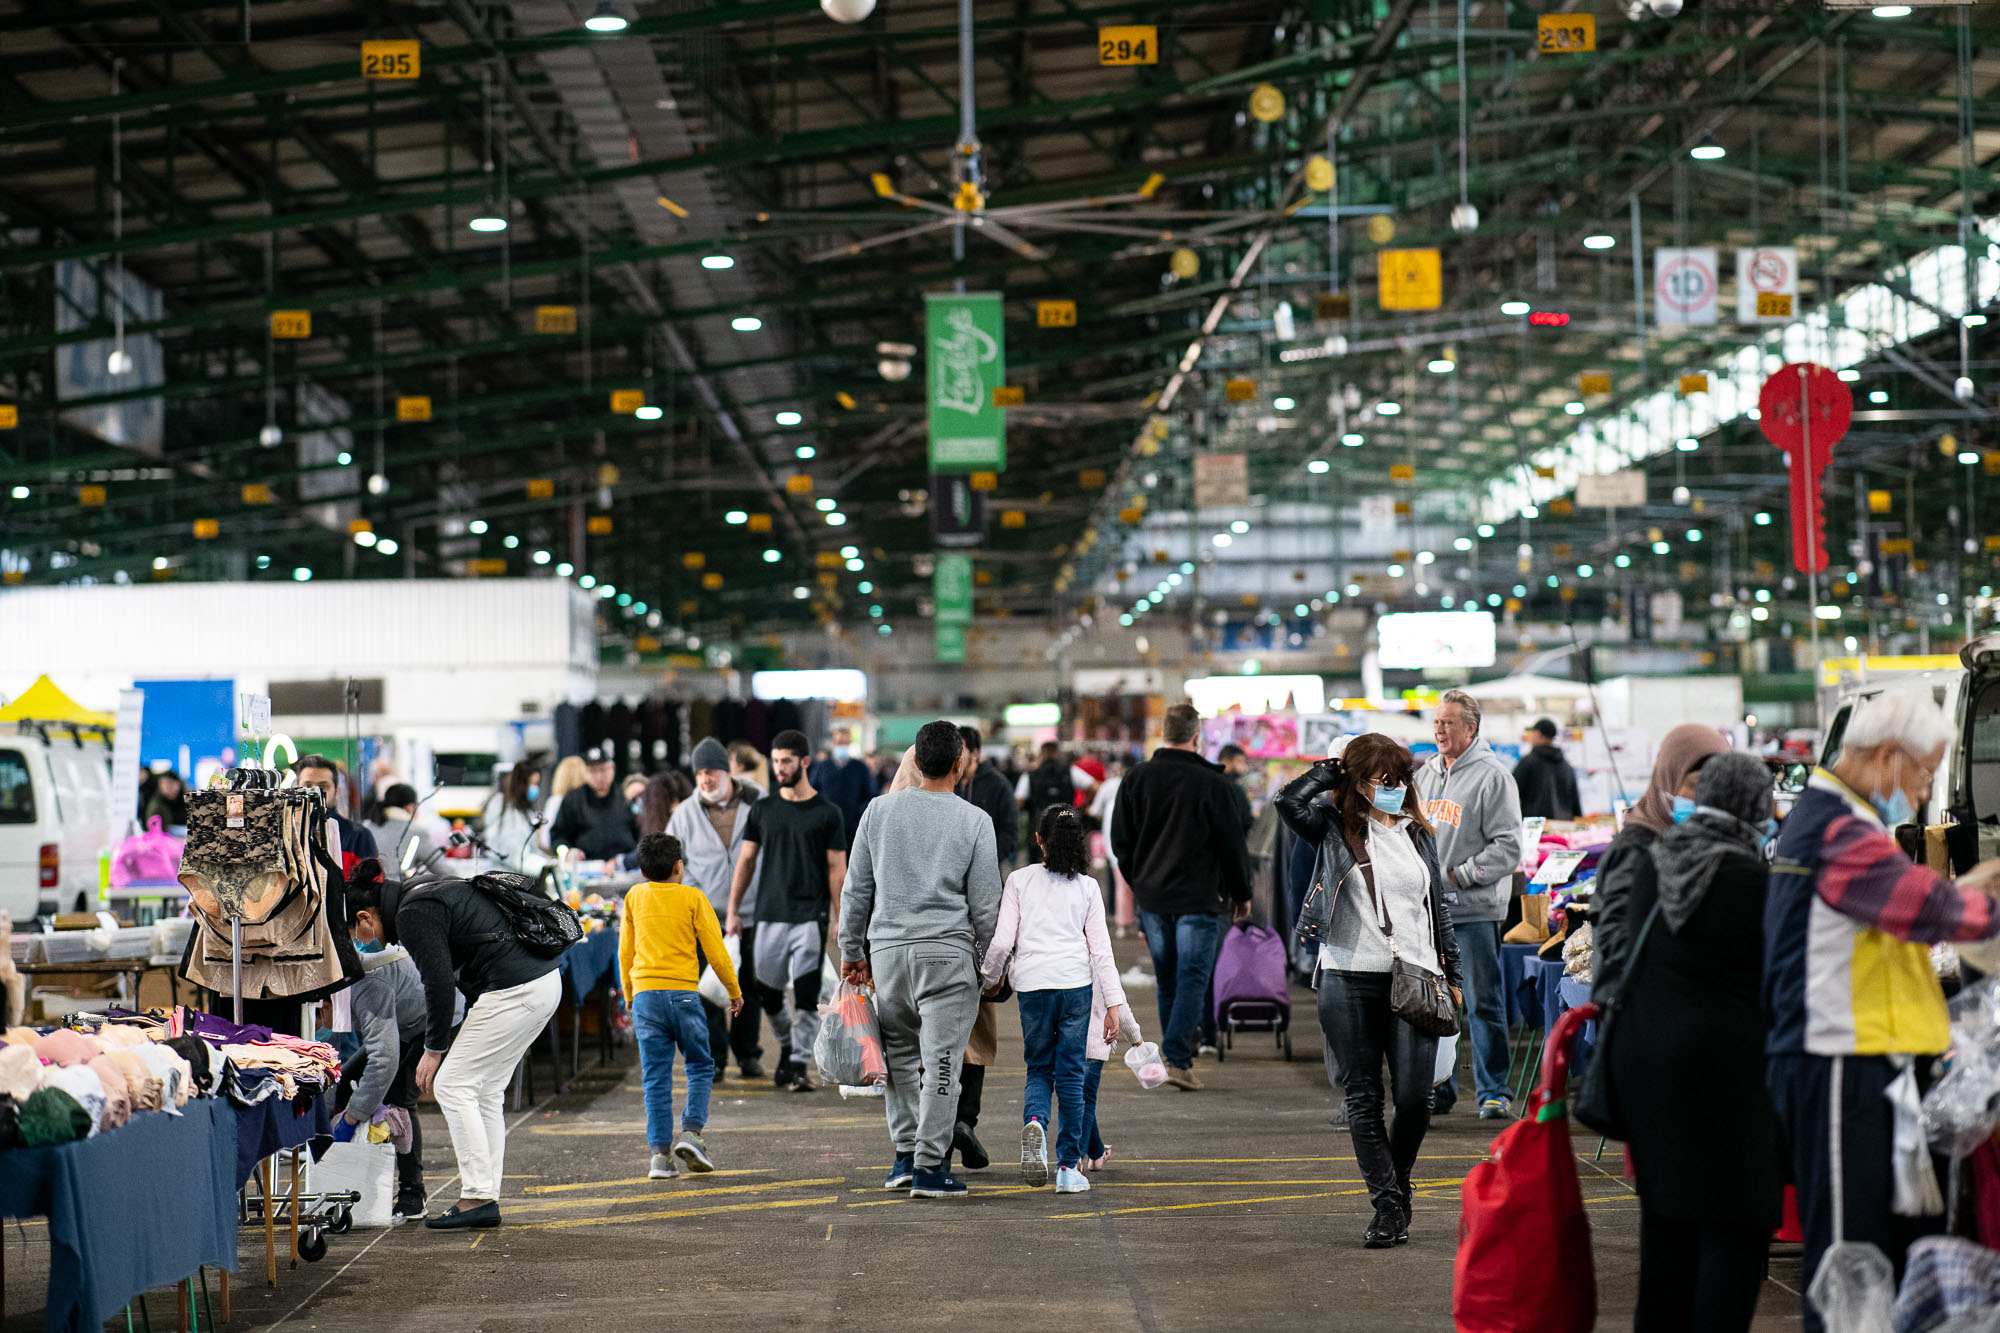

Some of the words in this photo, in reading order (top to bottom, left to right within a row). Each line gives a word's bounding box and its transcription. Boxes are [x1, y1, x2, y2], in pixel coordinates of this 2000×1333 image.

[1102, 40, 1147, 60] 294
[366, 54, 411, 74] 295
[1671, 270, 1704, 297] 10
[1772, 399, 1838, 422] KEY
